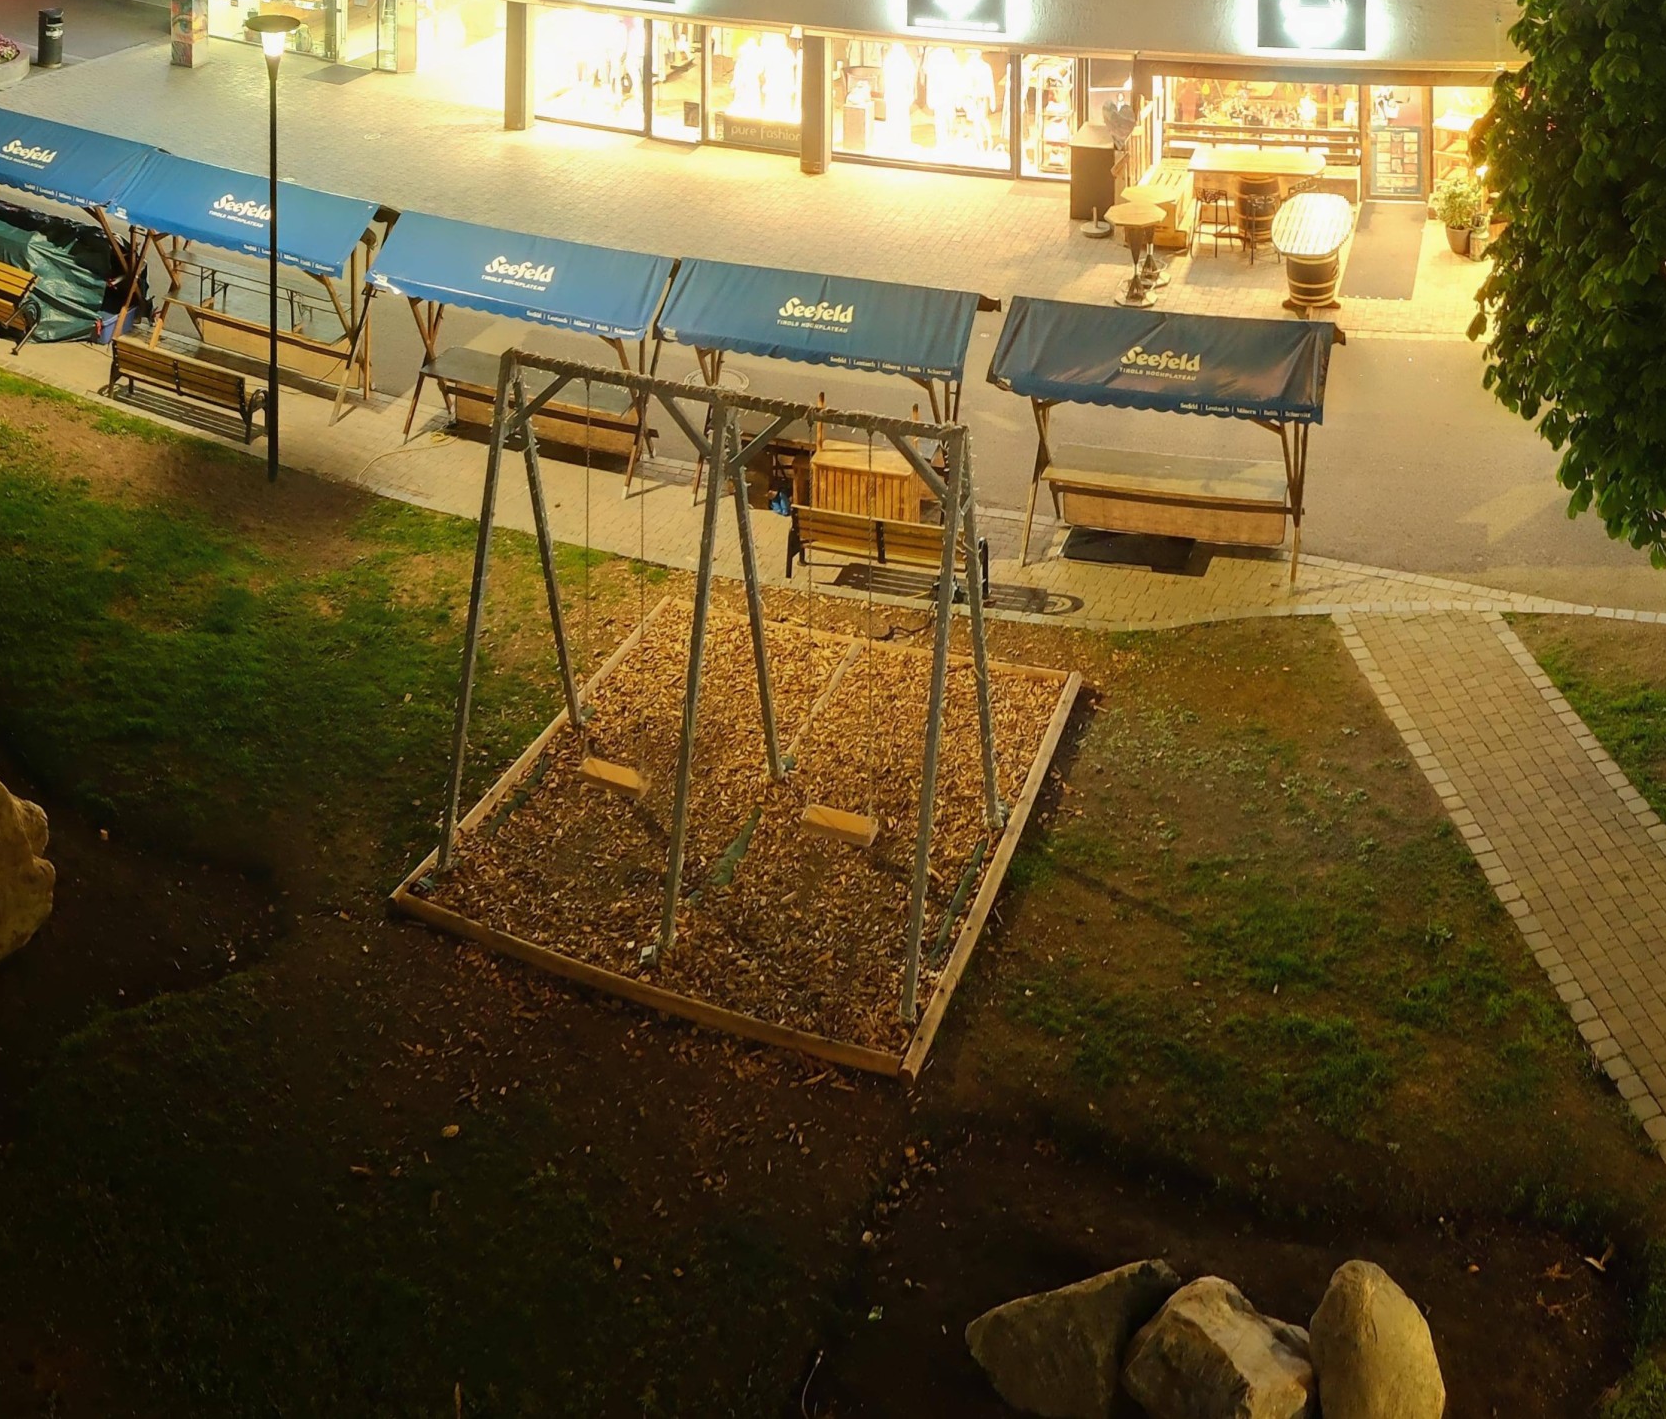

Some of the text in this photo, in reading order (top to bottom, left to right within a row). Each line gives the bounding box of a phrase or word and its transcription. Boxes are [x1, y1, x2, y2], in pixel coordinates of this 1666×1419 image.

[731, 124, 757, 140] pure
[2, 138, 58, 165] Seefeld
[485, 255, 555, 283] Seefeld
[778, 297, 854, 324] Seefeld
[1120, 345, 1201, 373] Seefeld
